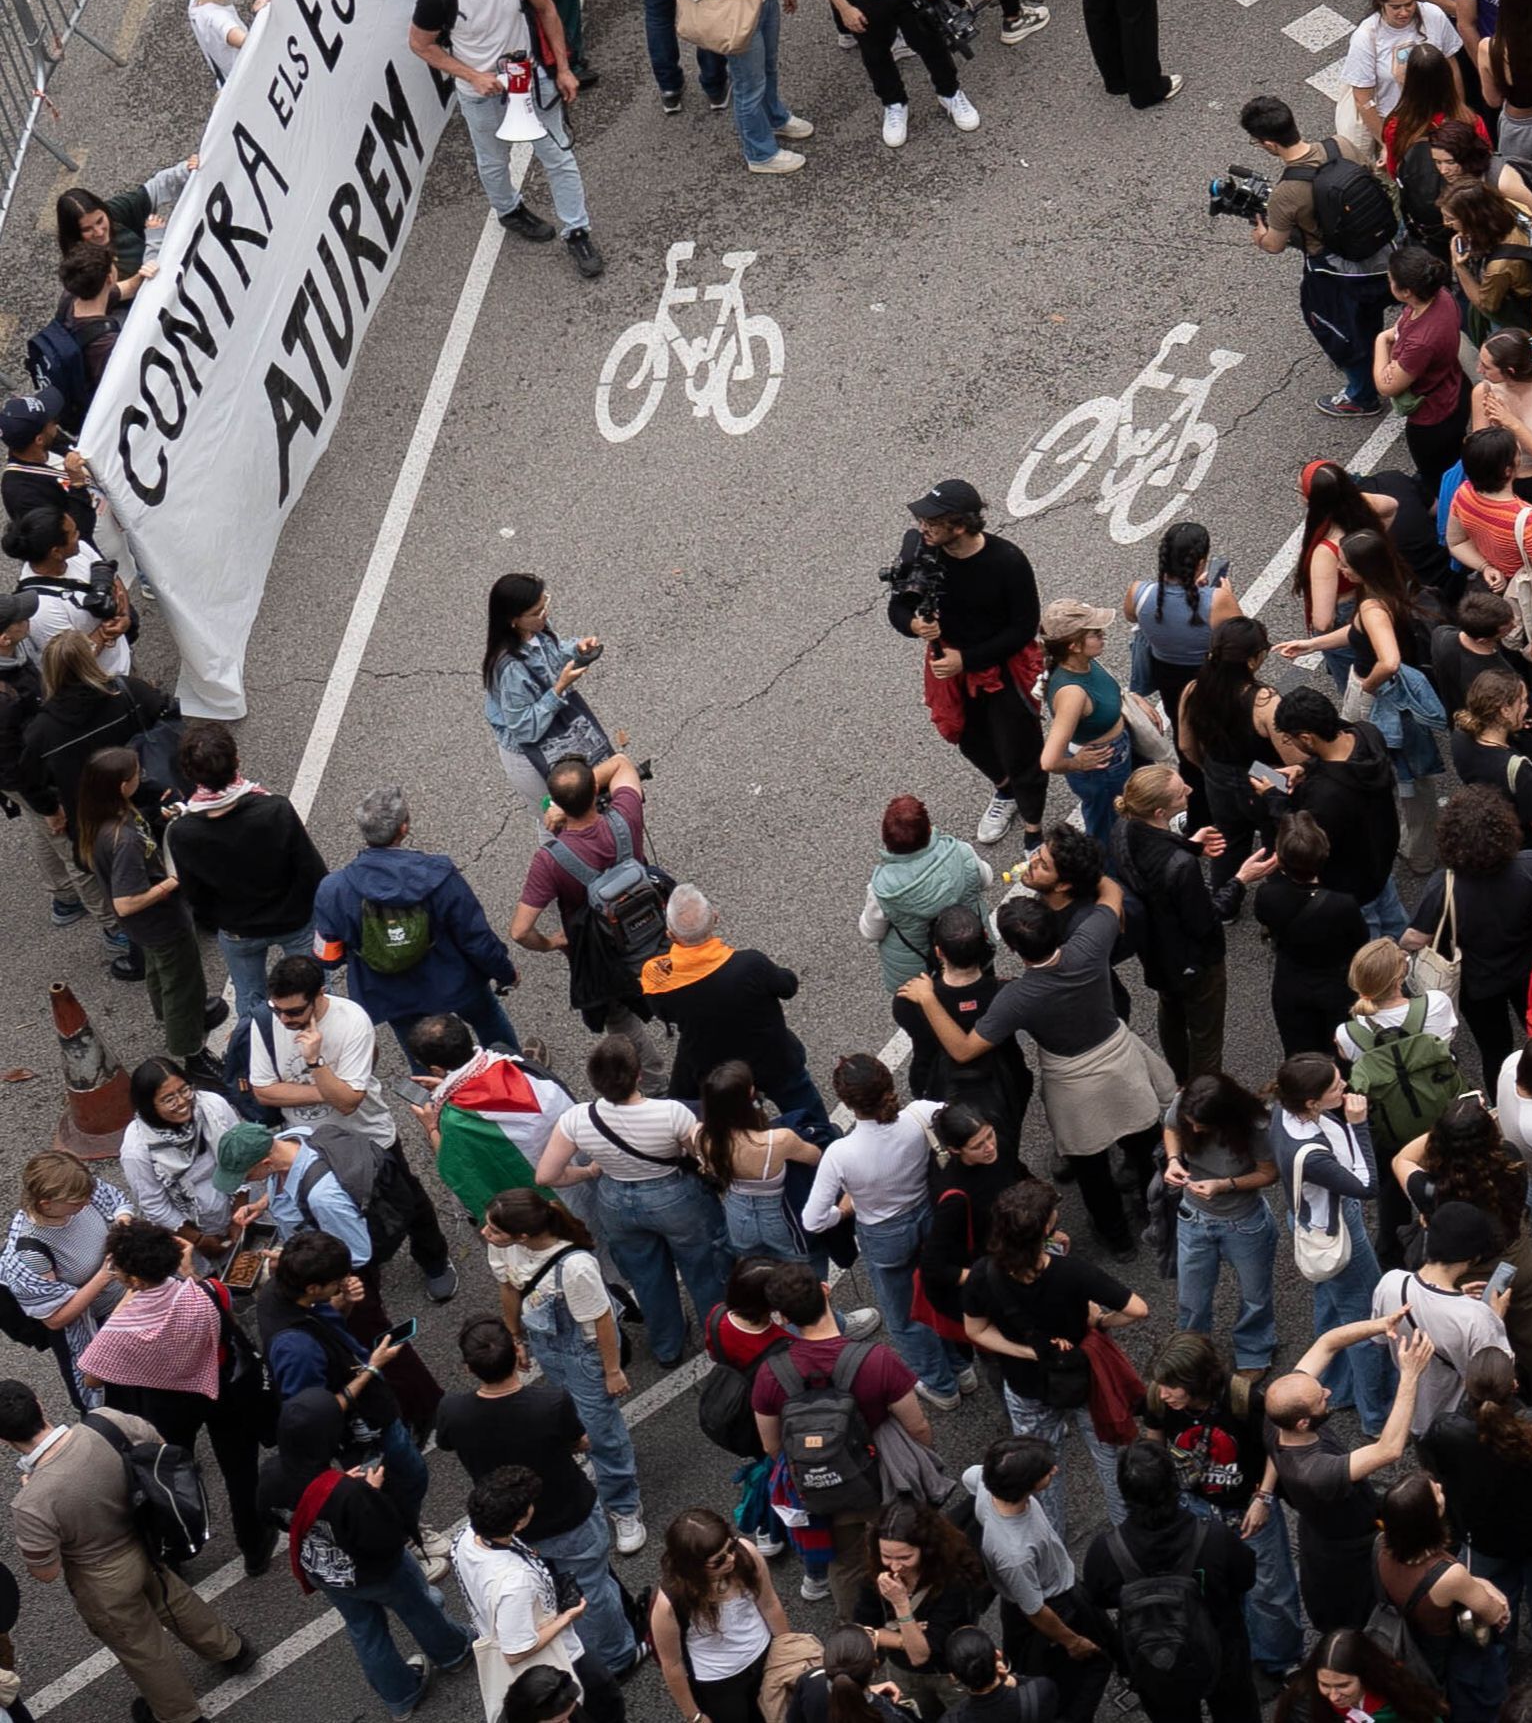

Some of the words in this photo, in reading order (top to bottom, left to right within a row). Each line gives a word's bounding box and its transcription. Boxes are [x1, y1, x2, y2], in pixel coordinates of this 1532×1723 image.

[118, 120, 289, 508] CONTRA
[266, 34, 311, 131] ELS
[263, 60, 425, 509] ATUREM
